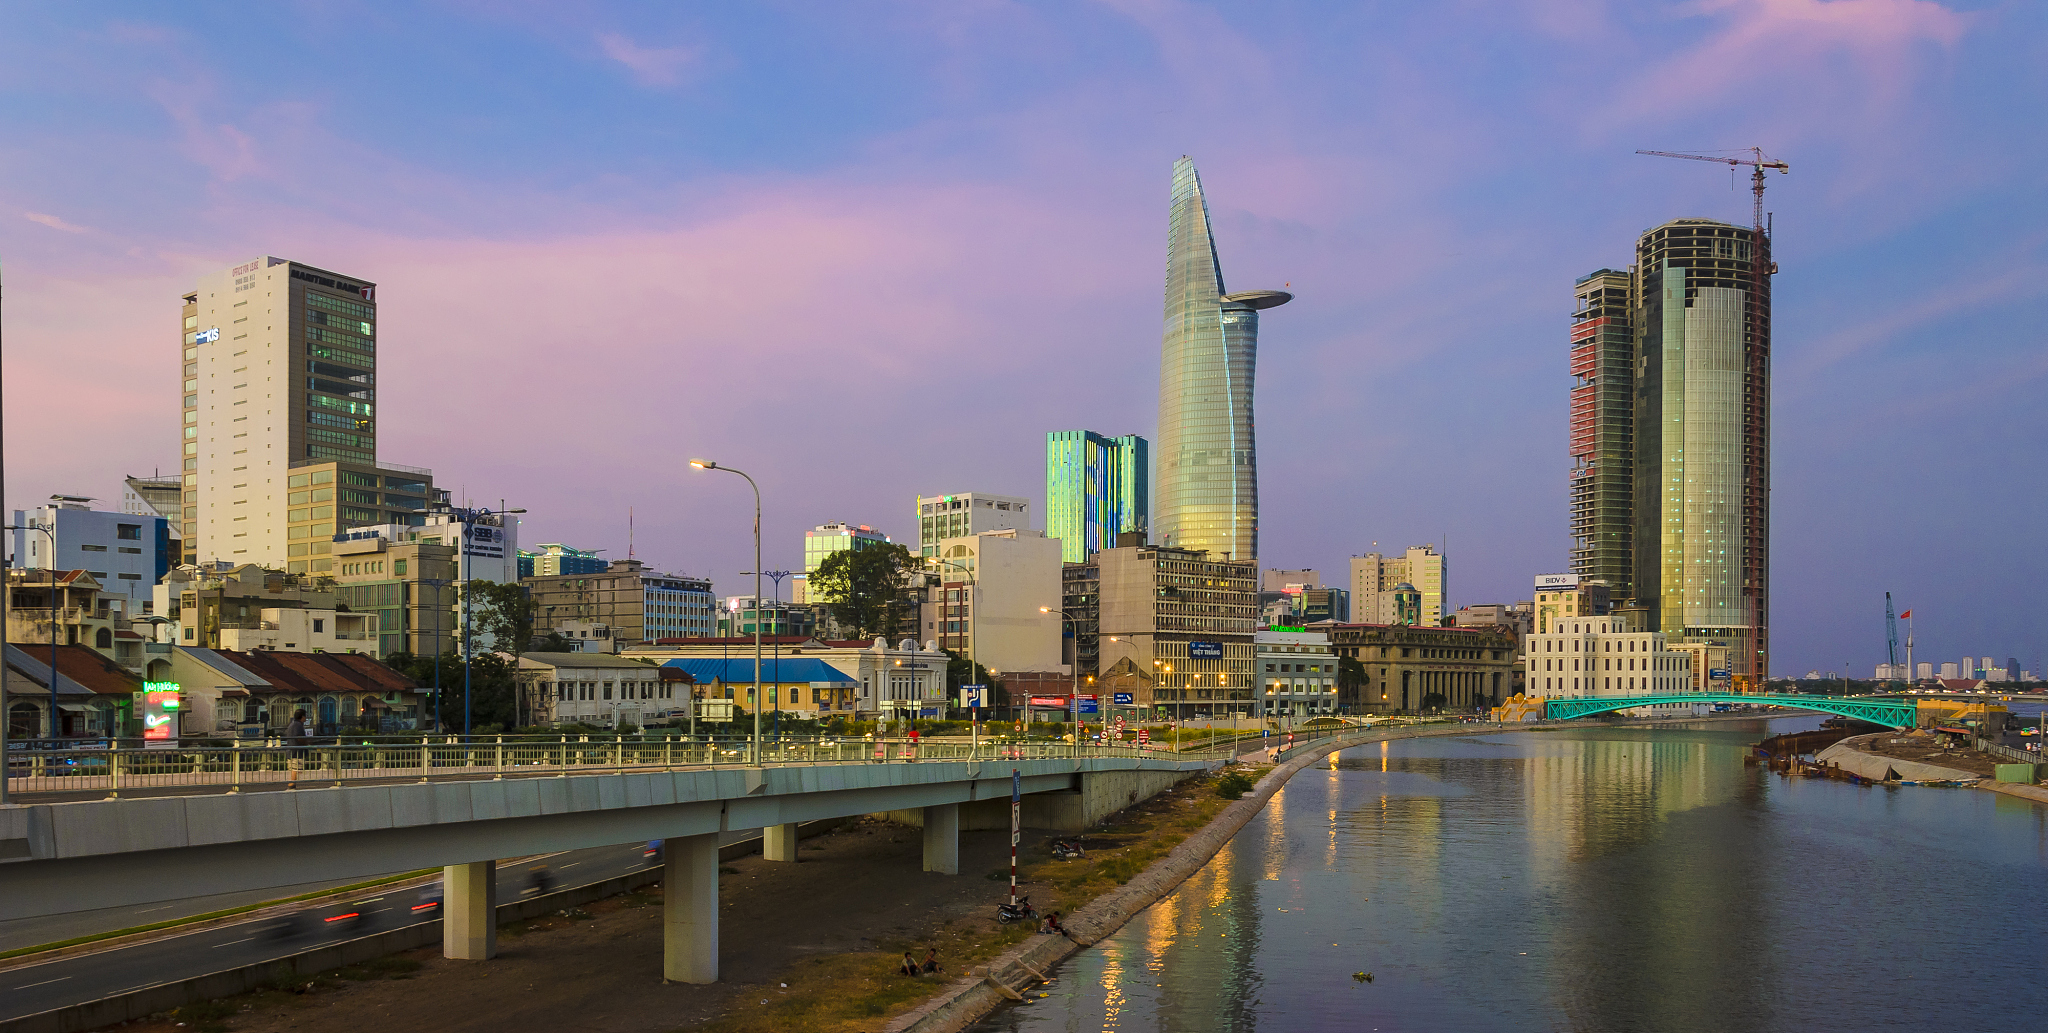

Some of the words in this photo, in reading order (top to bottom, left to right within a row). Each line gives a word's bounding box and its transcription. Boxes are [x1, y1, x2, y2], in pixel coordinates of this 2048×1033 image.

[290, 269, 336, 288] MARITIME
[336, 280, 361, 295] BANK
[206, 327, 219, 343] KIS
